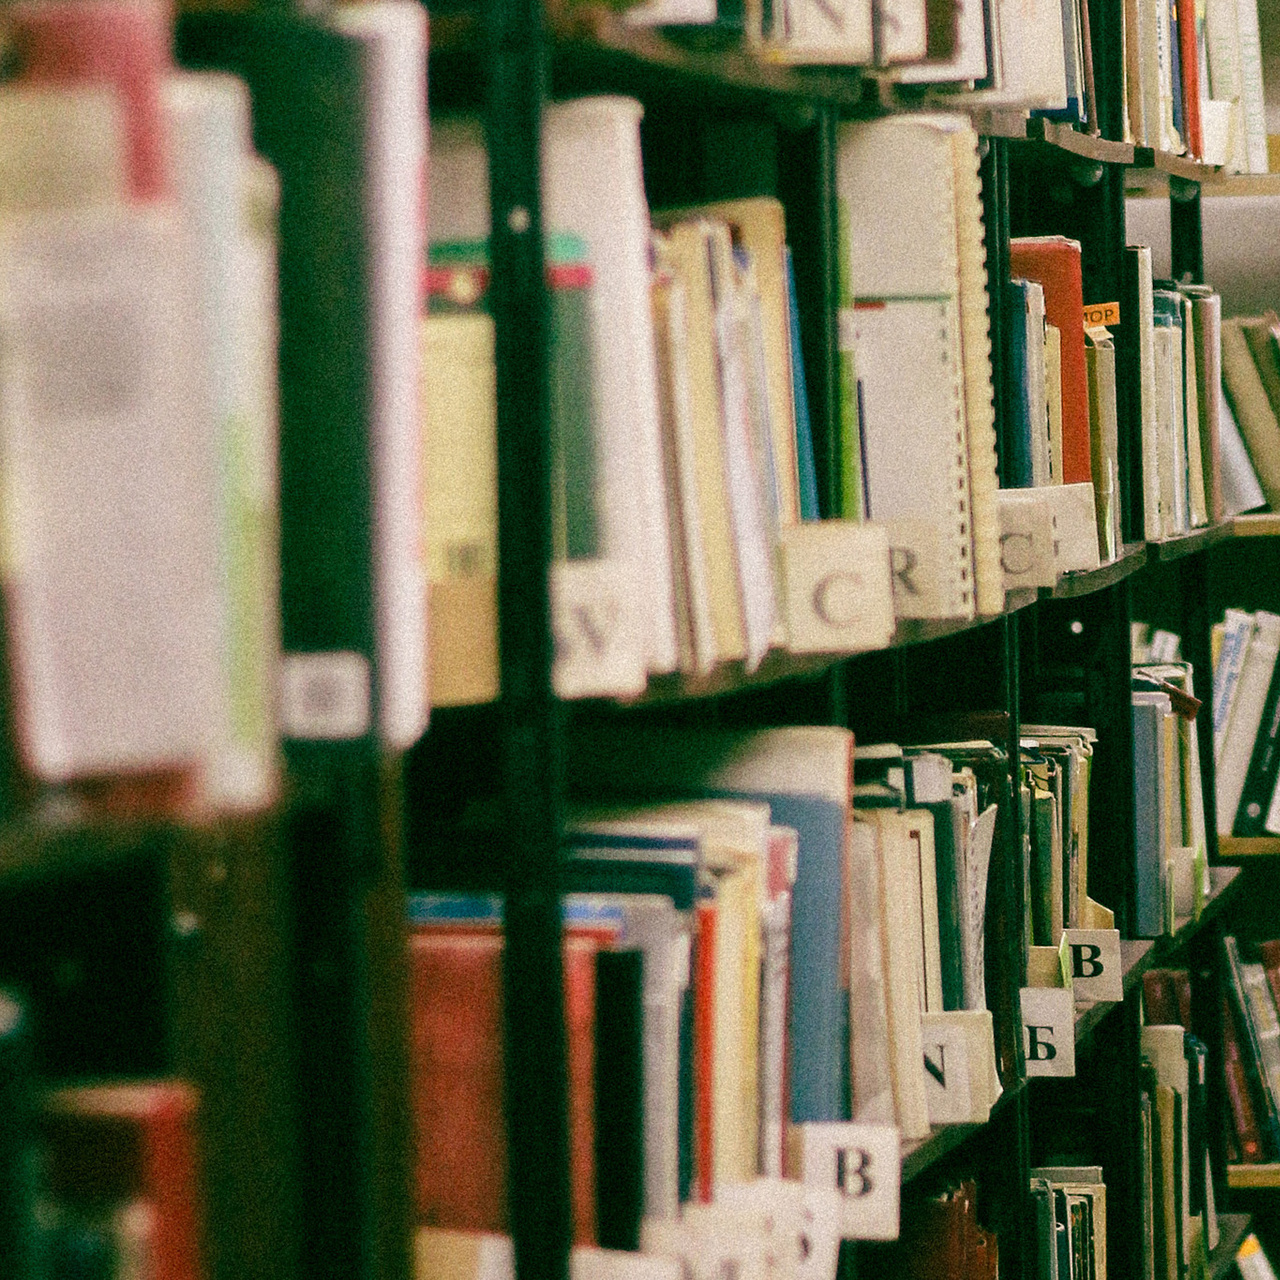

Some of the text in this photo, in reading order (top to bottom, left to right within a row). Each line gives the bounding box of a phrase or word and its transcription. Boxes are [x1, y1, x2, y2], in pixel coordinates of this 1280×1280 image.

[889, 545, 921, 597] R
[812, 570, 866, 629] C
[1025, 1024, 1058, 1062] Б
